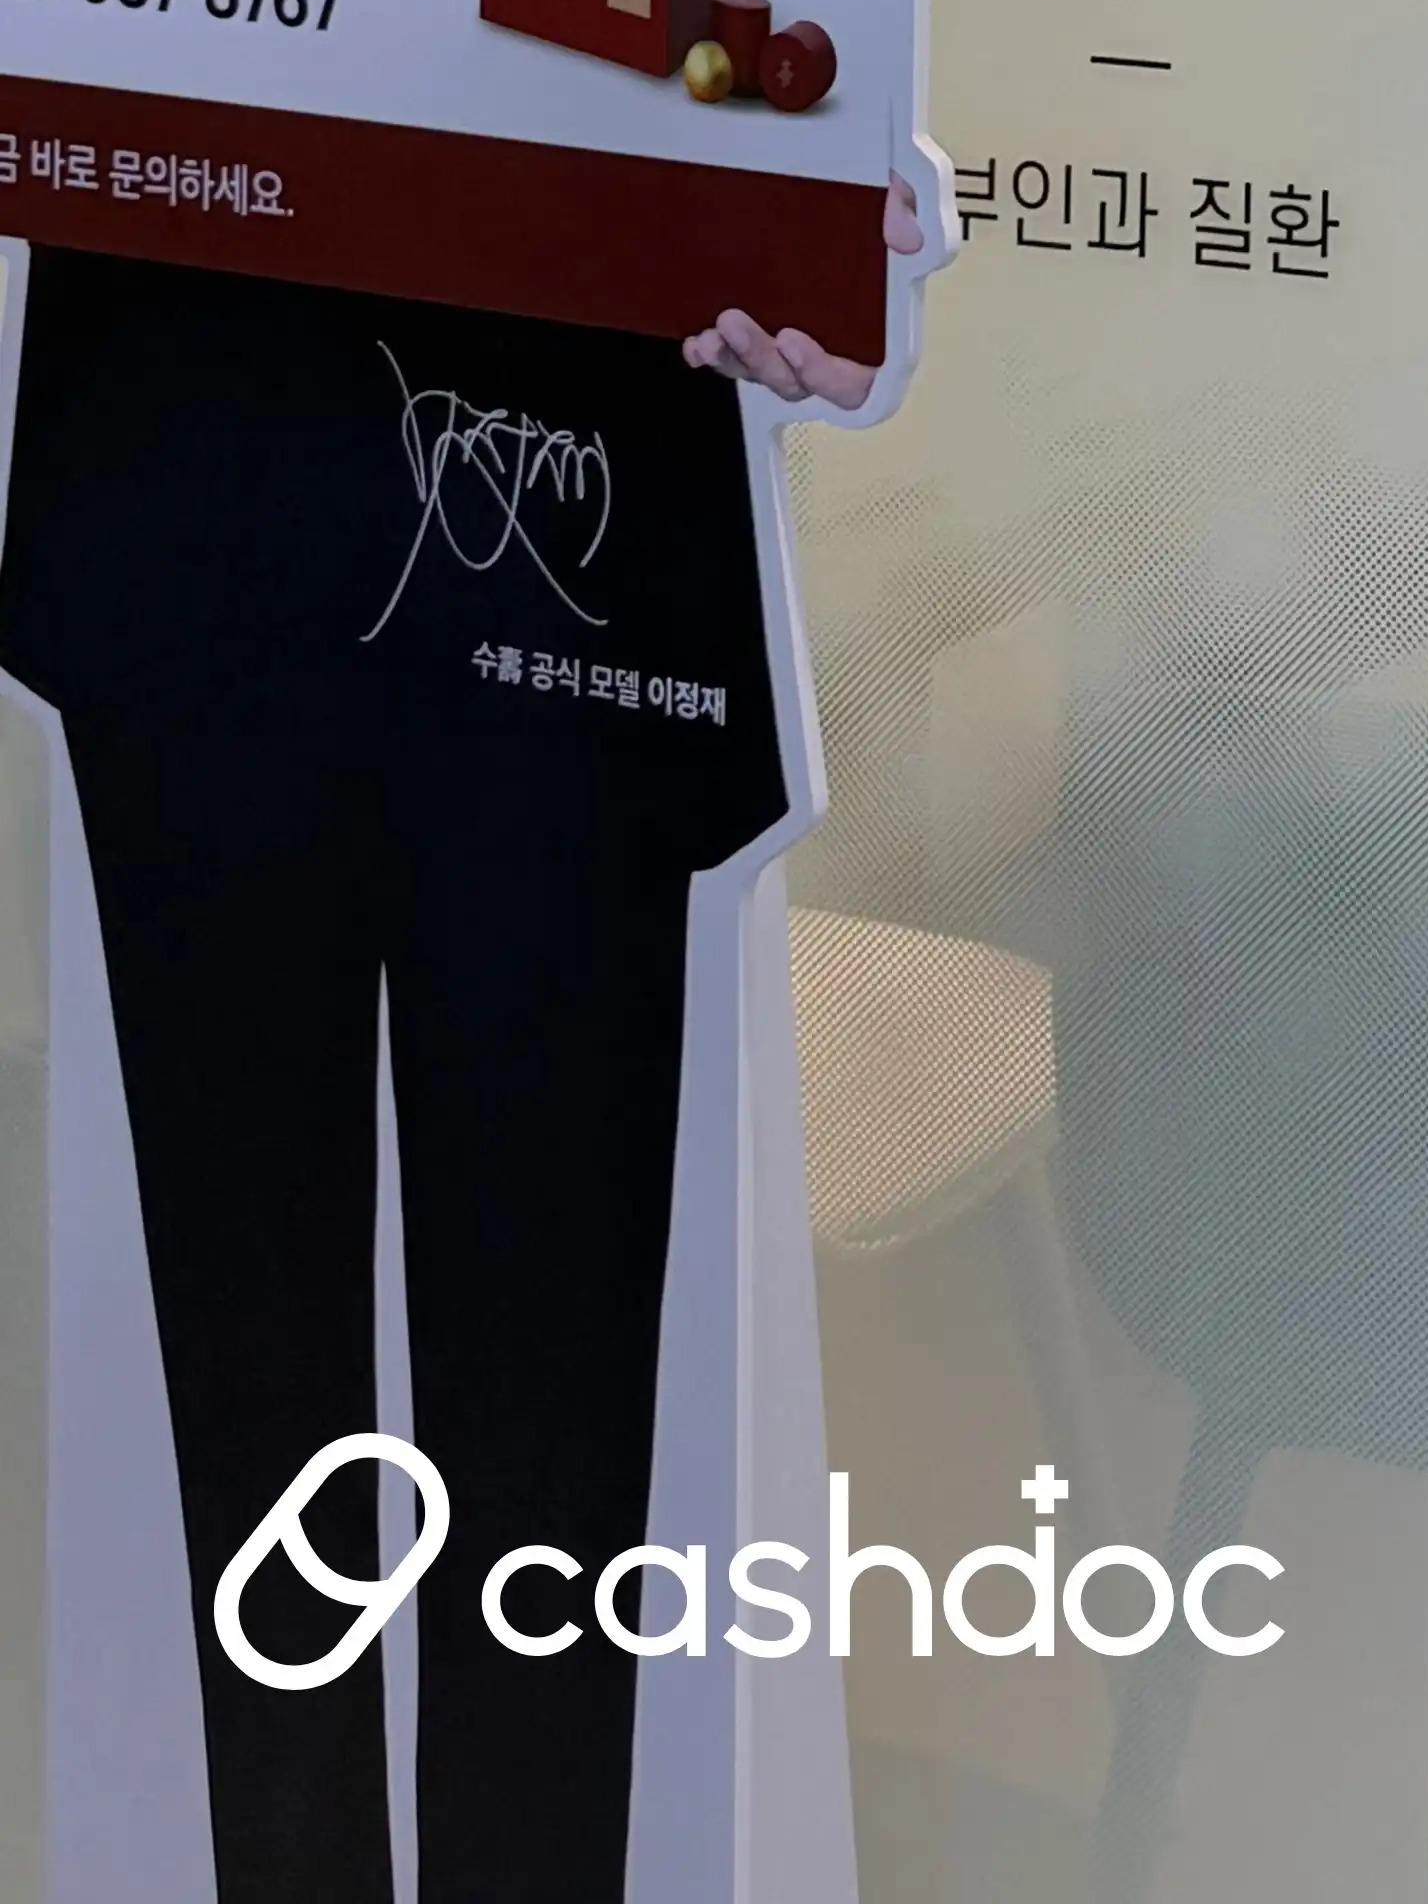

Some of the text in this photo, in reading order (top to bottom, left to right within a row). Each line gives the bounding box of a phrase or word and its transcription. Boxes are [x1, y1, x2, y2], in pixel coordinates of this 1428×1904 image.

[31, 138, 100, 190] 바로
[108, 149, 294, 217] 문의하세요.
[1189, 177, 1340, 279] 질환
[529, 651, 580, 697] 공식
[587, 664, 641, 709] 모델
[647, 676, 726, 727] 이정재
